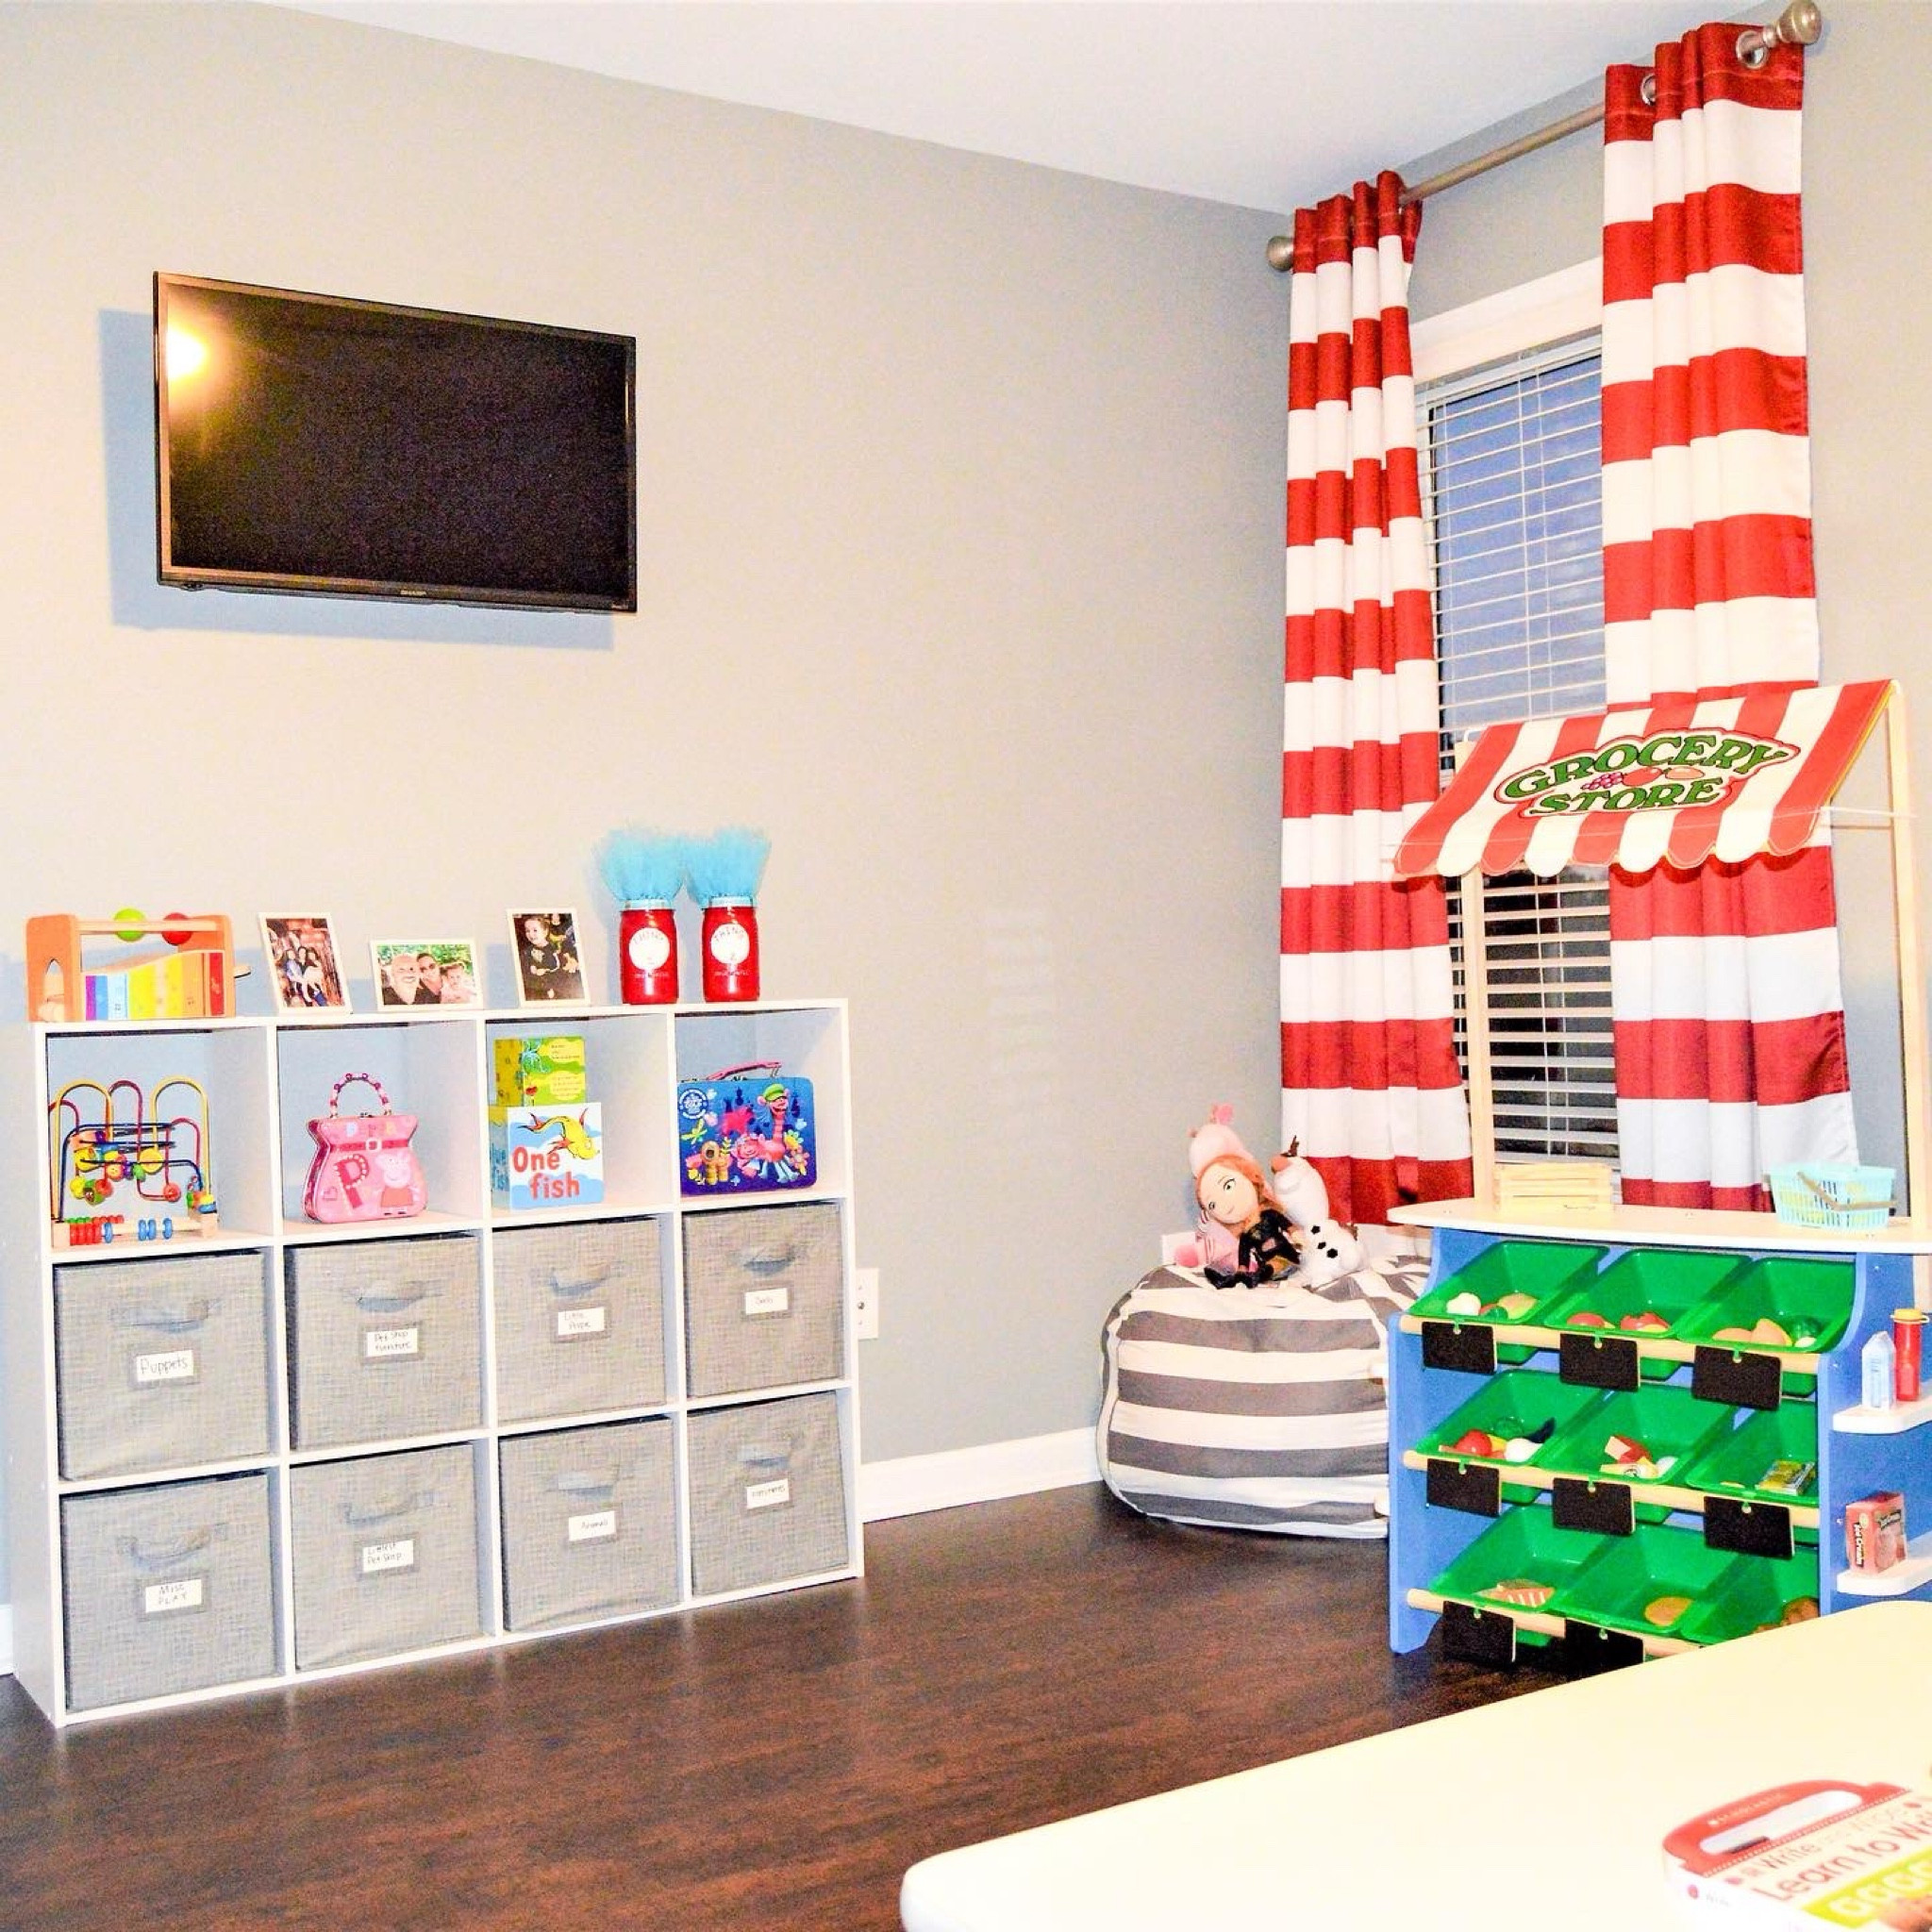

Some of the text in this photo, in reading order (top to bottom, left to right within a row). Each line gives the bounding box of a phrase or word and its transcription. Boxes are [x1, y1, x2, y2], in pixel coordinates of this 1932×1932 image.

[1505, 734, 1790, 799] GROCERY
[1529, 777, 1724, 815] STORE
[512, 1144, 560, 1174] One
[529, 1171, 580, 1201] fish
[1752, 1855, 1867, 1901] Learn
[1846, 1840, 1901, 1857] to
